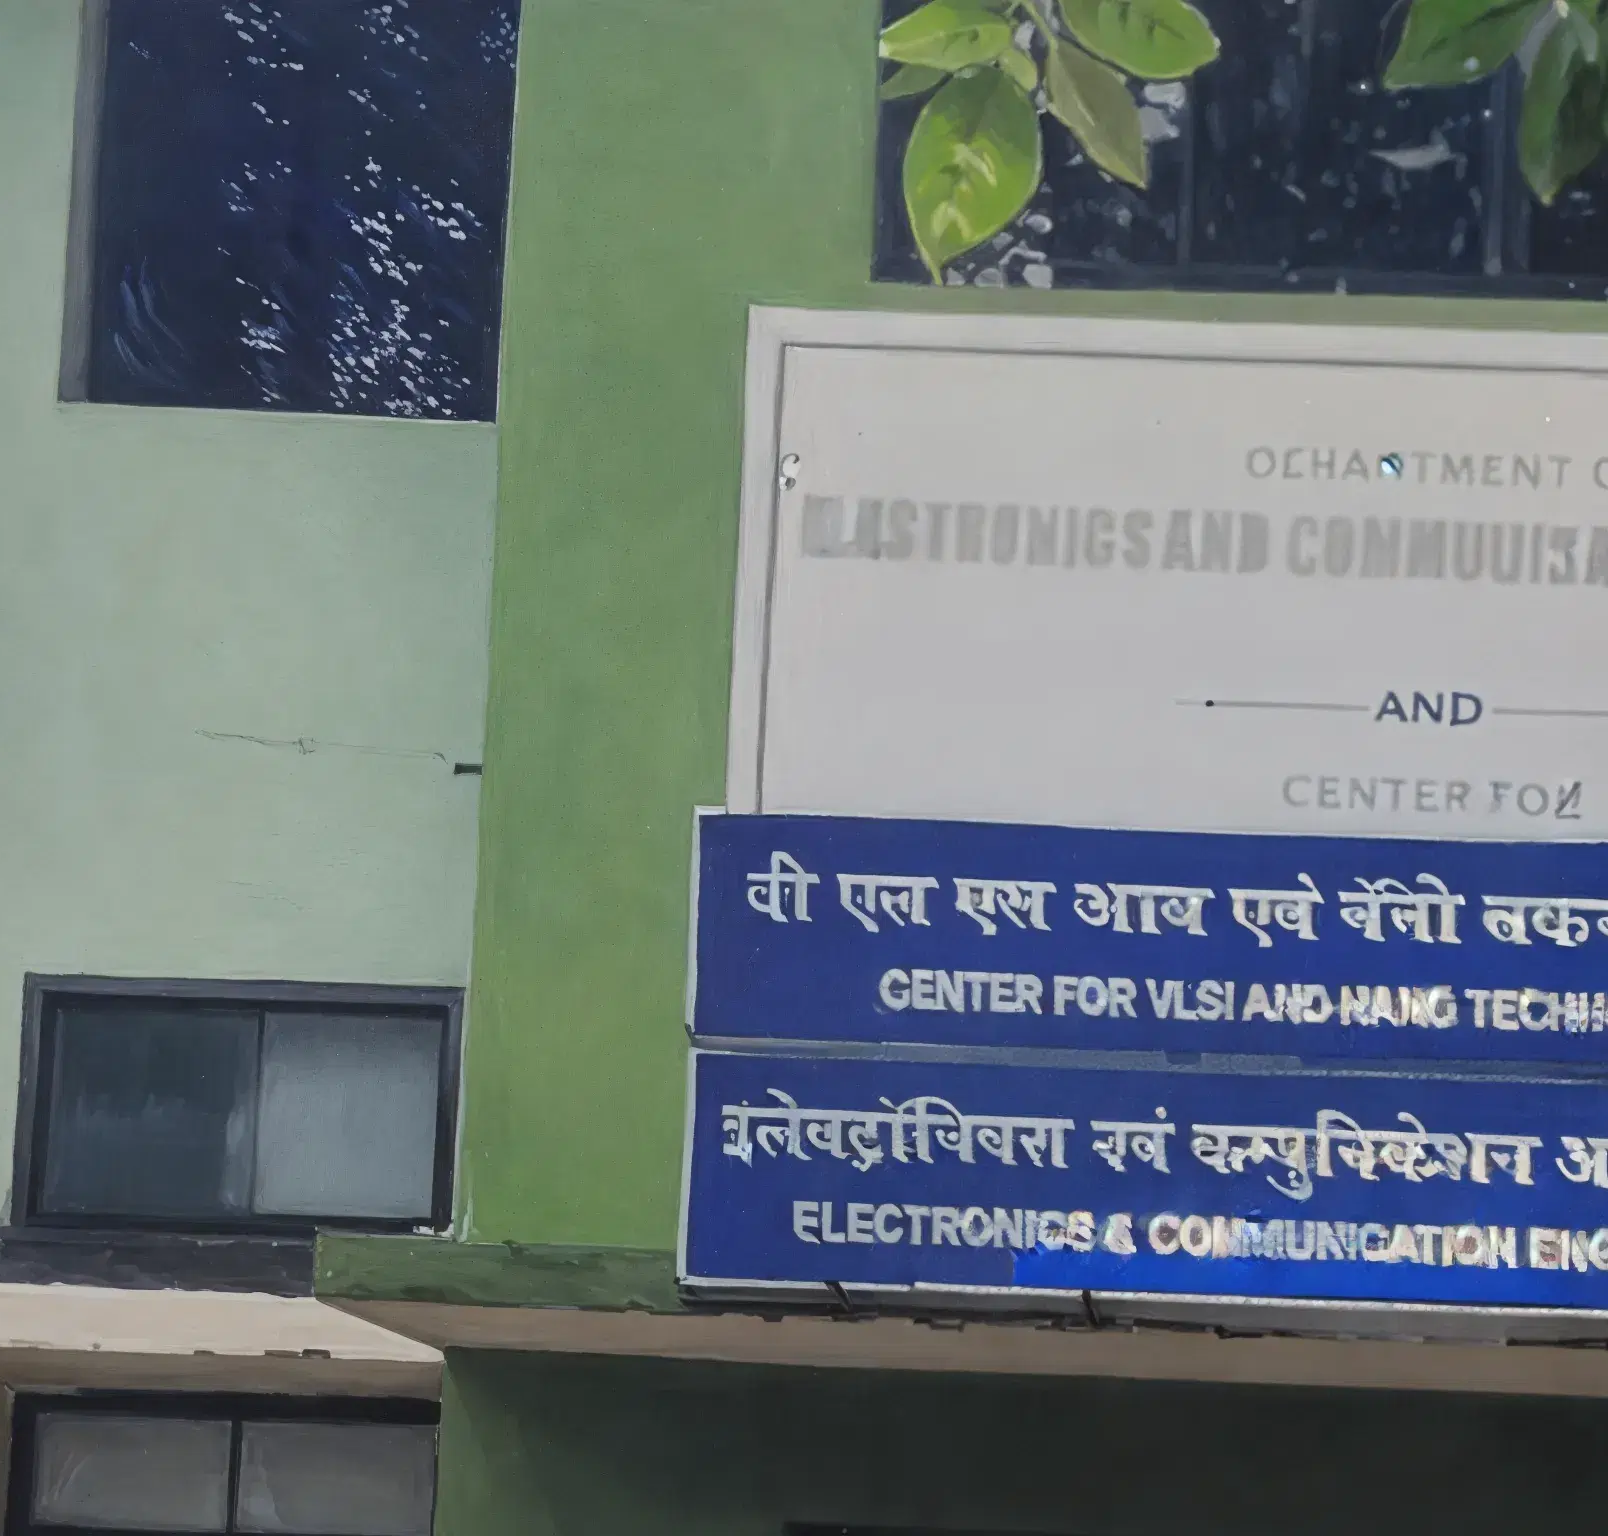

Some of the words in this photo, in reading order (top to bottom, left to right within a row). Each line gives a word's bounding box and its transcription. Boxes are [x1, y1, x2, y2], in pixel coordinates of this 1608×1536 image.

[1374, 690, 1484, 727] AND
[1282, 774, 1472, 814] CENTER
[1052, 974, 1139, 1019] FOR
[1143, 977, 1236, 1023] VLSI
